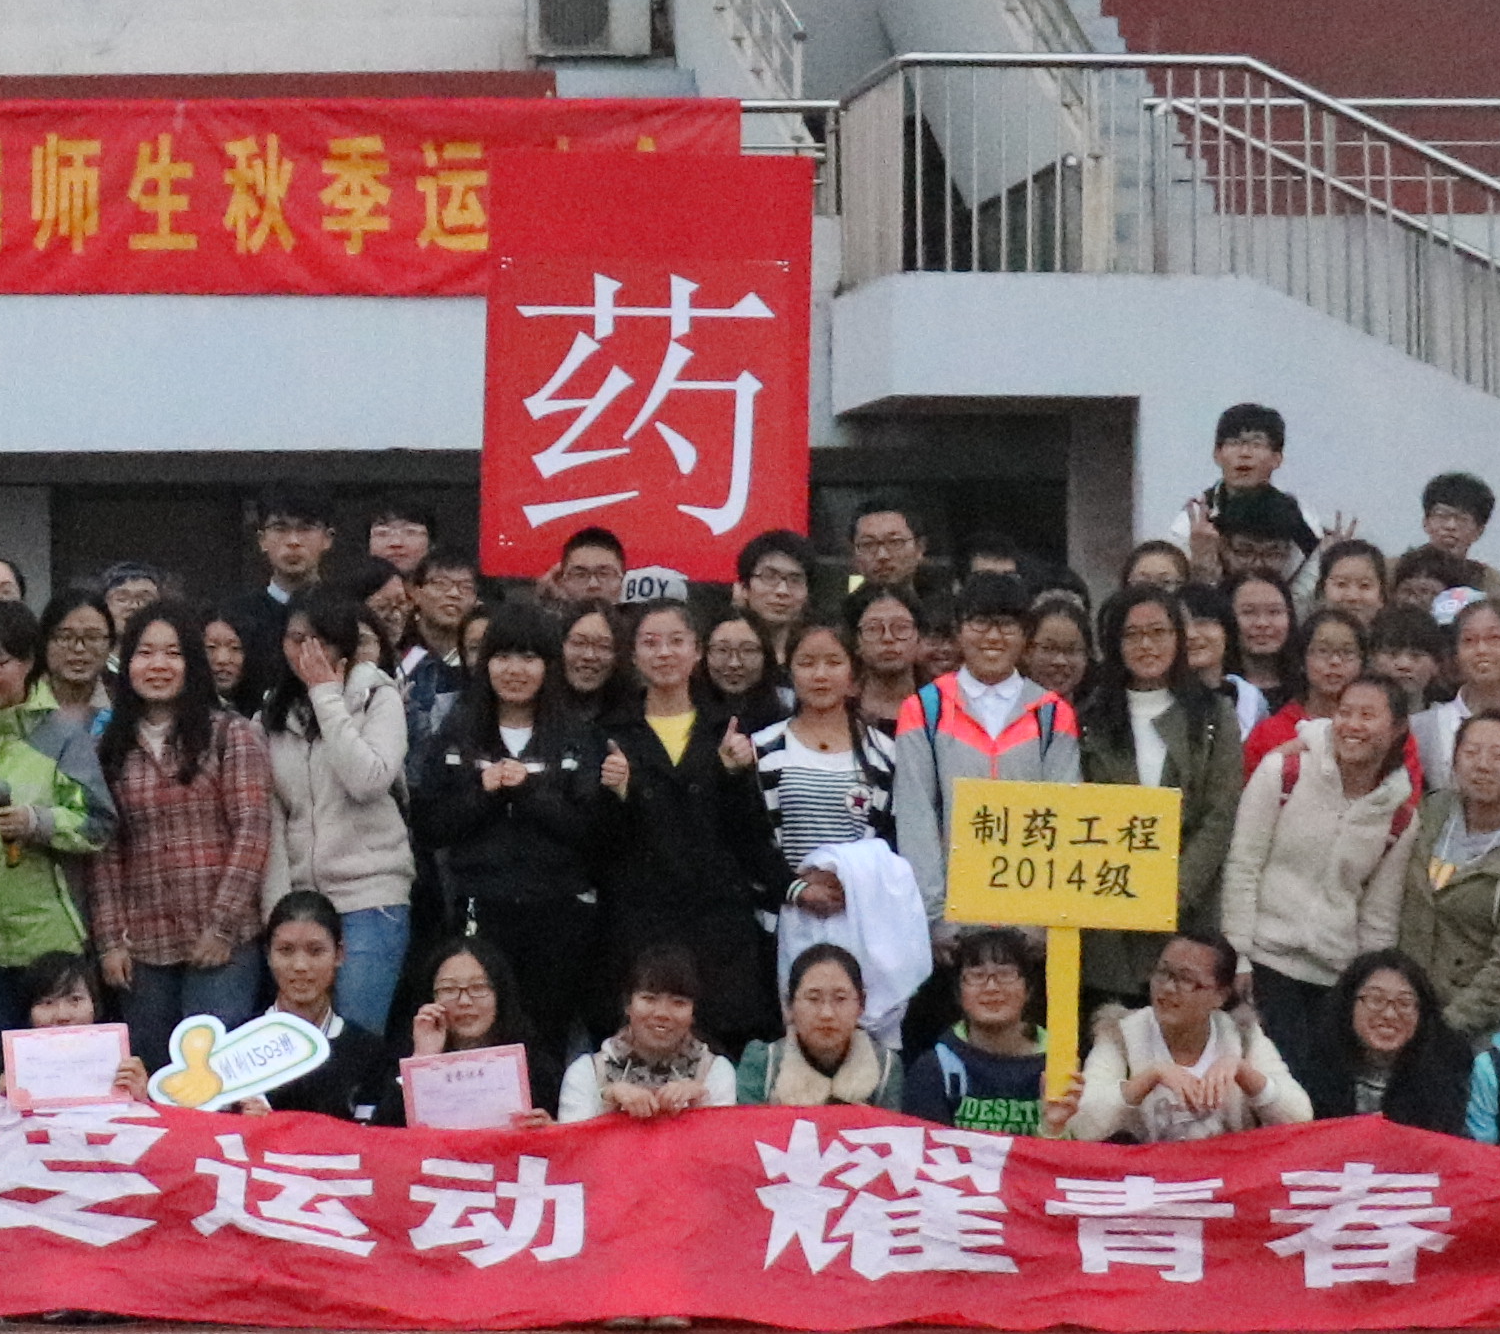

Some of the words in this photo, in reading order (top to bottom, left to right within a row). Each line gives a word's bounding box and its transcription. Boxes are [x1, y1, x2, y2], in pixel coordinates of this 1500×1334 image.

[515, 271, 776, 537] 药
[626, 576, 670, 601] BOY
[969, 804, 1161, 853] 制药工程
[988, 855, 1139, 899] 2014级
[753, 1118, 1455, 1289] 耀青春
